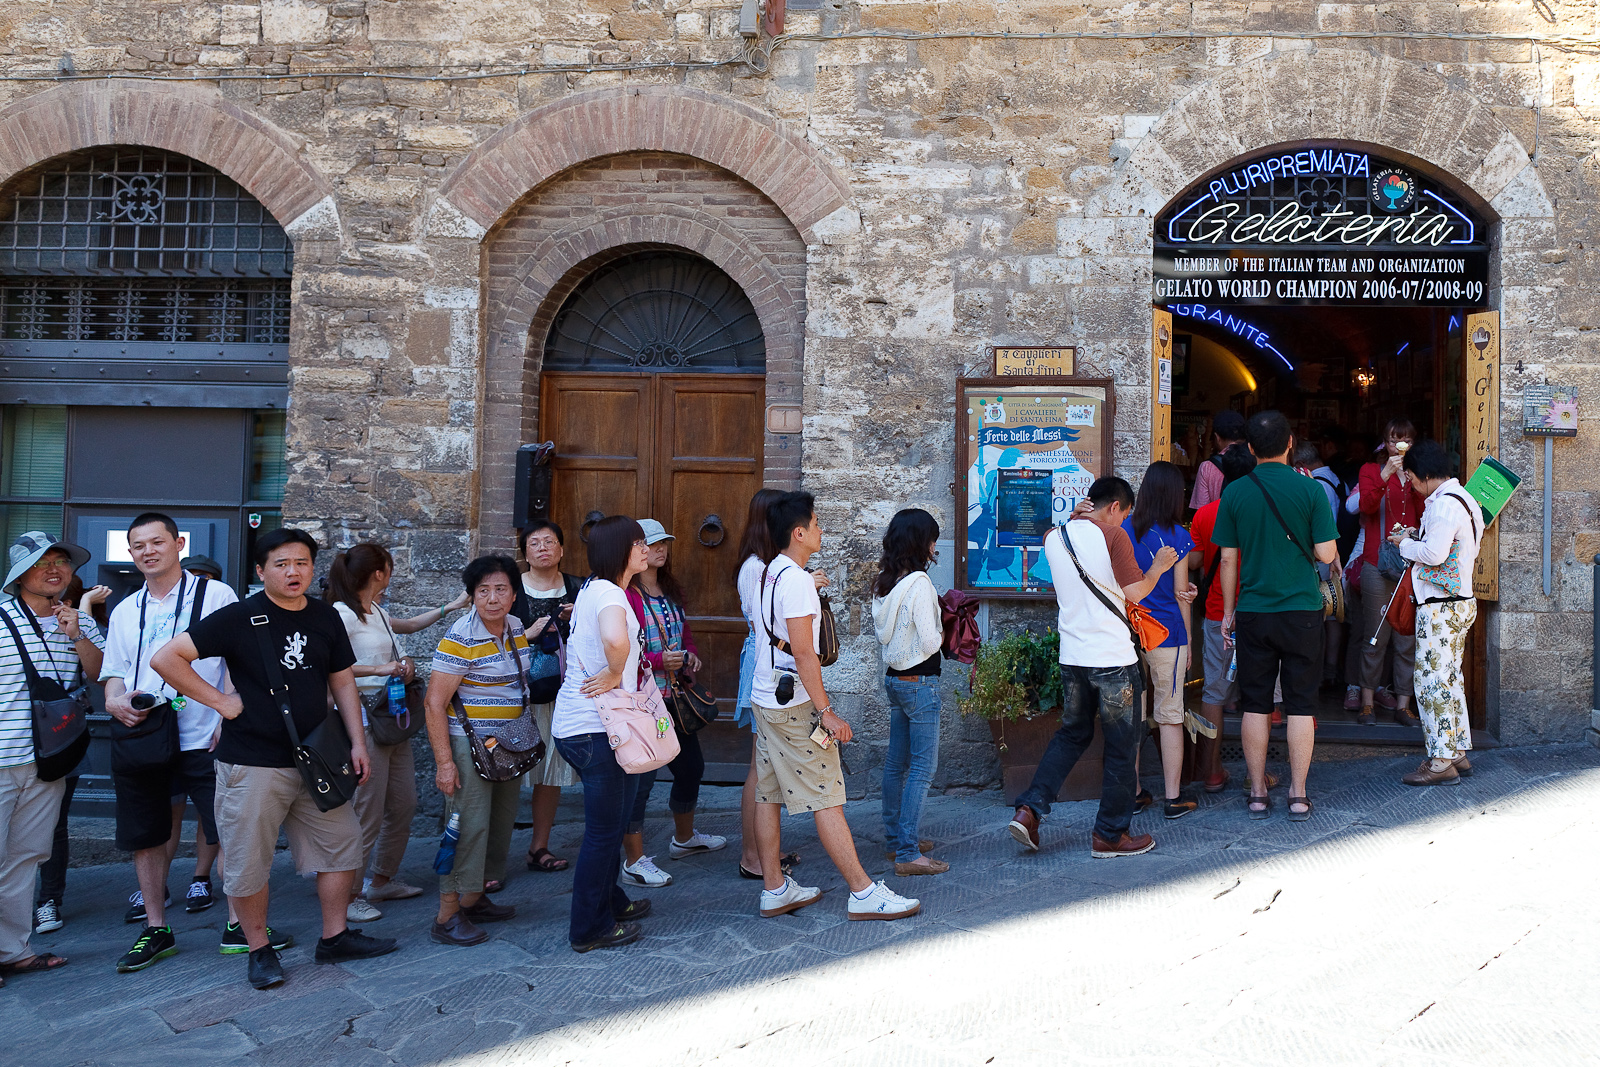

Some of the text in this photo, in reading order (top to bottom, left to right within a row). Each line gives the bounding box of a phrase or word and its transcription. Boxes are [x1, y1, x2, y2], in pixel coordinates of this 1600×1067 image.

[1209, 149, 1370, 203] PLURIPREMIATA
[1372, 168, 1393, 201] GELATERIA
[1403, 177, 1415, 204] PIAZZA
[1188, 200, 1454, 247] Gelateria
[1174, 257, 1465, 274] MEMBER OF THE ITALIAN TEAM AND ORGANIZATION
[1155, 276, 1483, 302] GELATO WORLD CHAMPION 2006-07/2008-09
[1176, 303, 1270, 349] GRANITE
[1012, 349, 1062, 359] Cavalieri
[1002, 364, 1063, 376] Santa Fina
[1514, 360, 1525, 374] 4
[782, 410, 788, 427] 1
[983, 428, 1062, 443] Ferie delle Messi
[1059, 474, 1091, 486] 18 19
